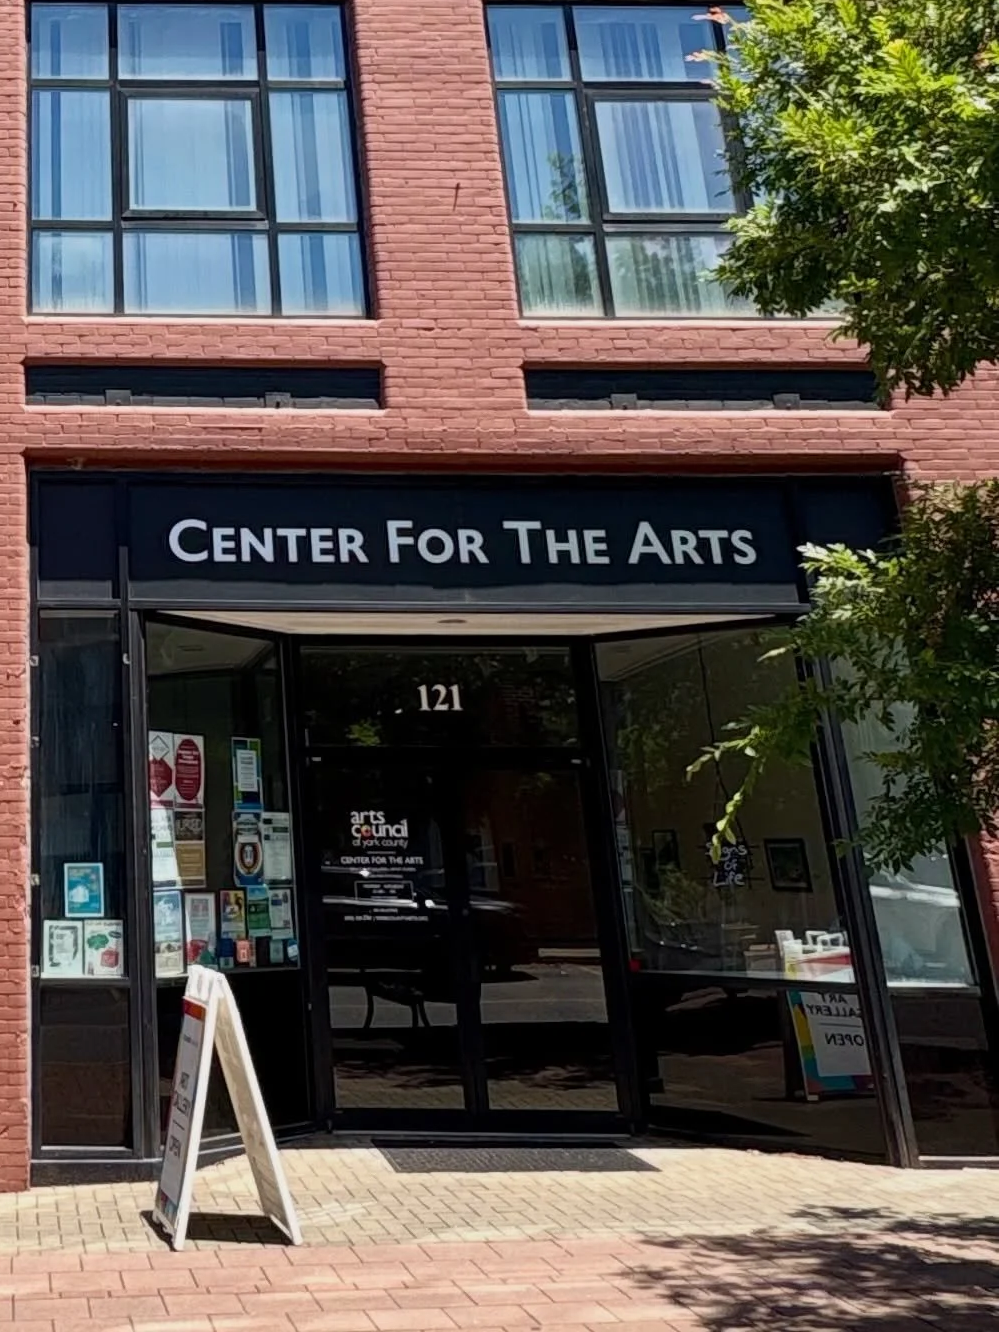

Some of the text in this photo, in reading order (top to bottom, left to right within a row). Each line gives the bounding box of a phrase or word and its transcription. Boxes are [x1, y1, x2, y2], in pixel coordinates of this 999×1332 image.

[416, 683, 464, 711] 121
[350, 810, 386, 824] arts
[351, 818, 409, 838] council
[704, 842, 748, 861] Sgns
